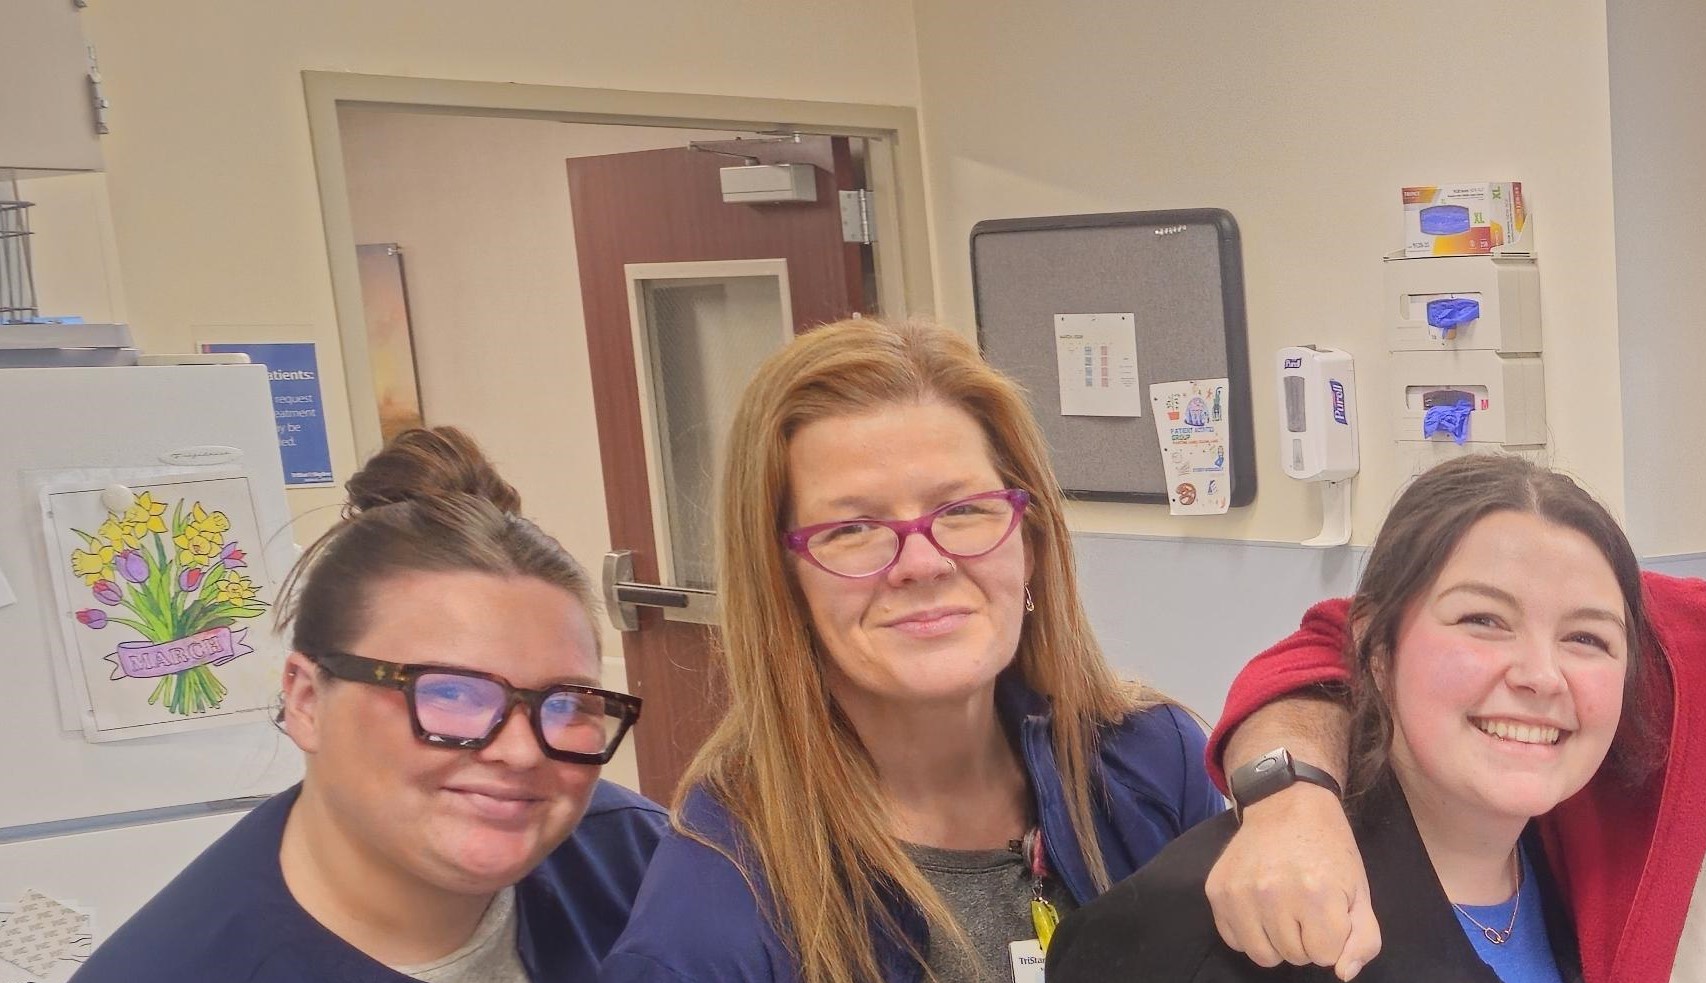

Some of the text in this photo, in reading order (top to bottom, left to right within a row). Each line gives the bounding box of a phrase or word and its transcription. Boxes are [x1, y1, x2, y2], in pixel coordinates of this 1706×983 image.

[1492, 186, 1501, 199] XL
[1473, 212, 1485, 224] XL
[267, 369, 315, 381] atients:
[275, 408, 316, 417] eatment
[288, 423, 301, 432] be
[281, 437, 297, 446] ed.
[128, 635, 224, 672] MARCH
